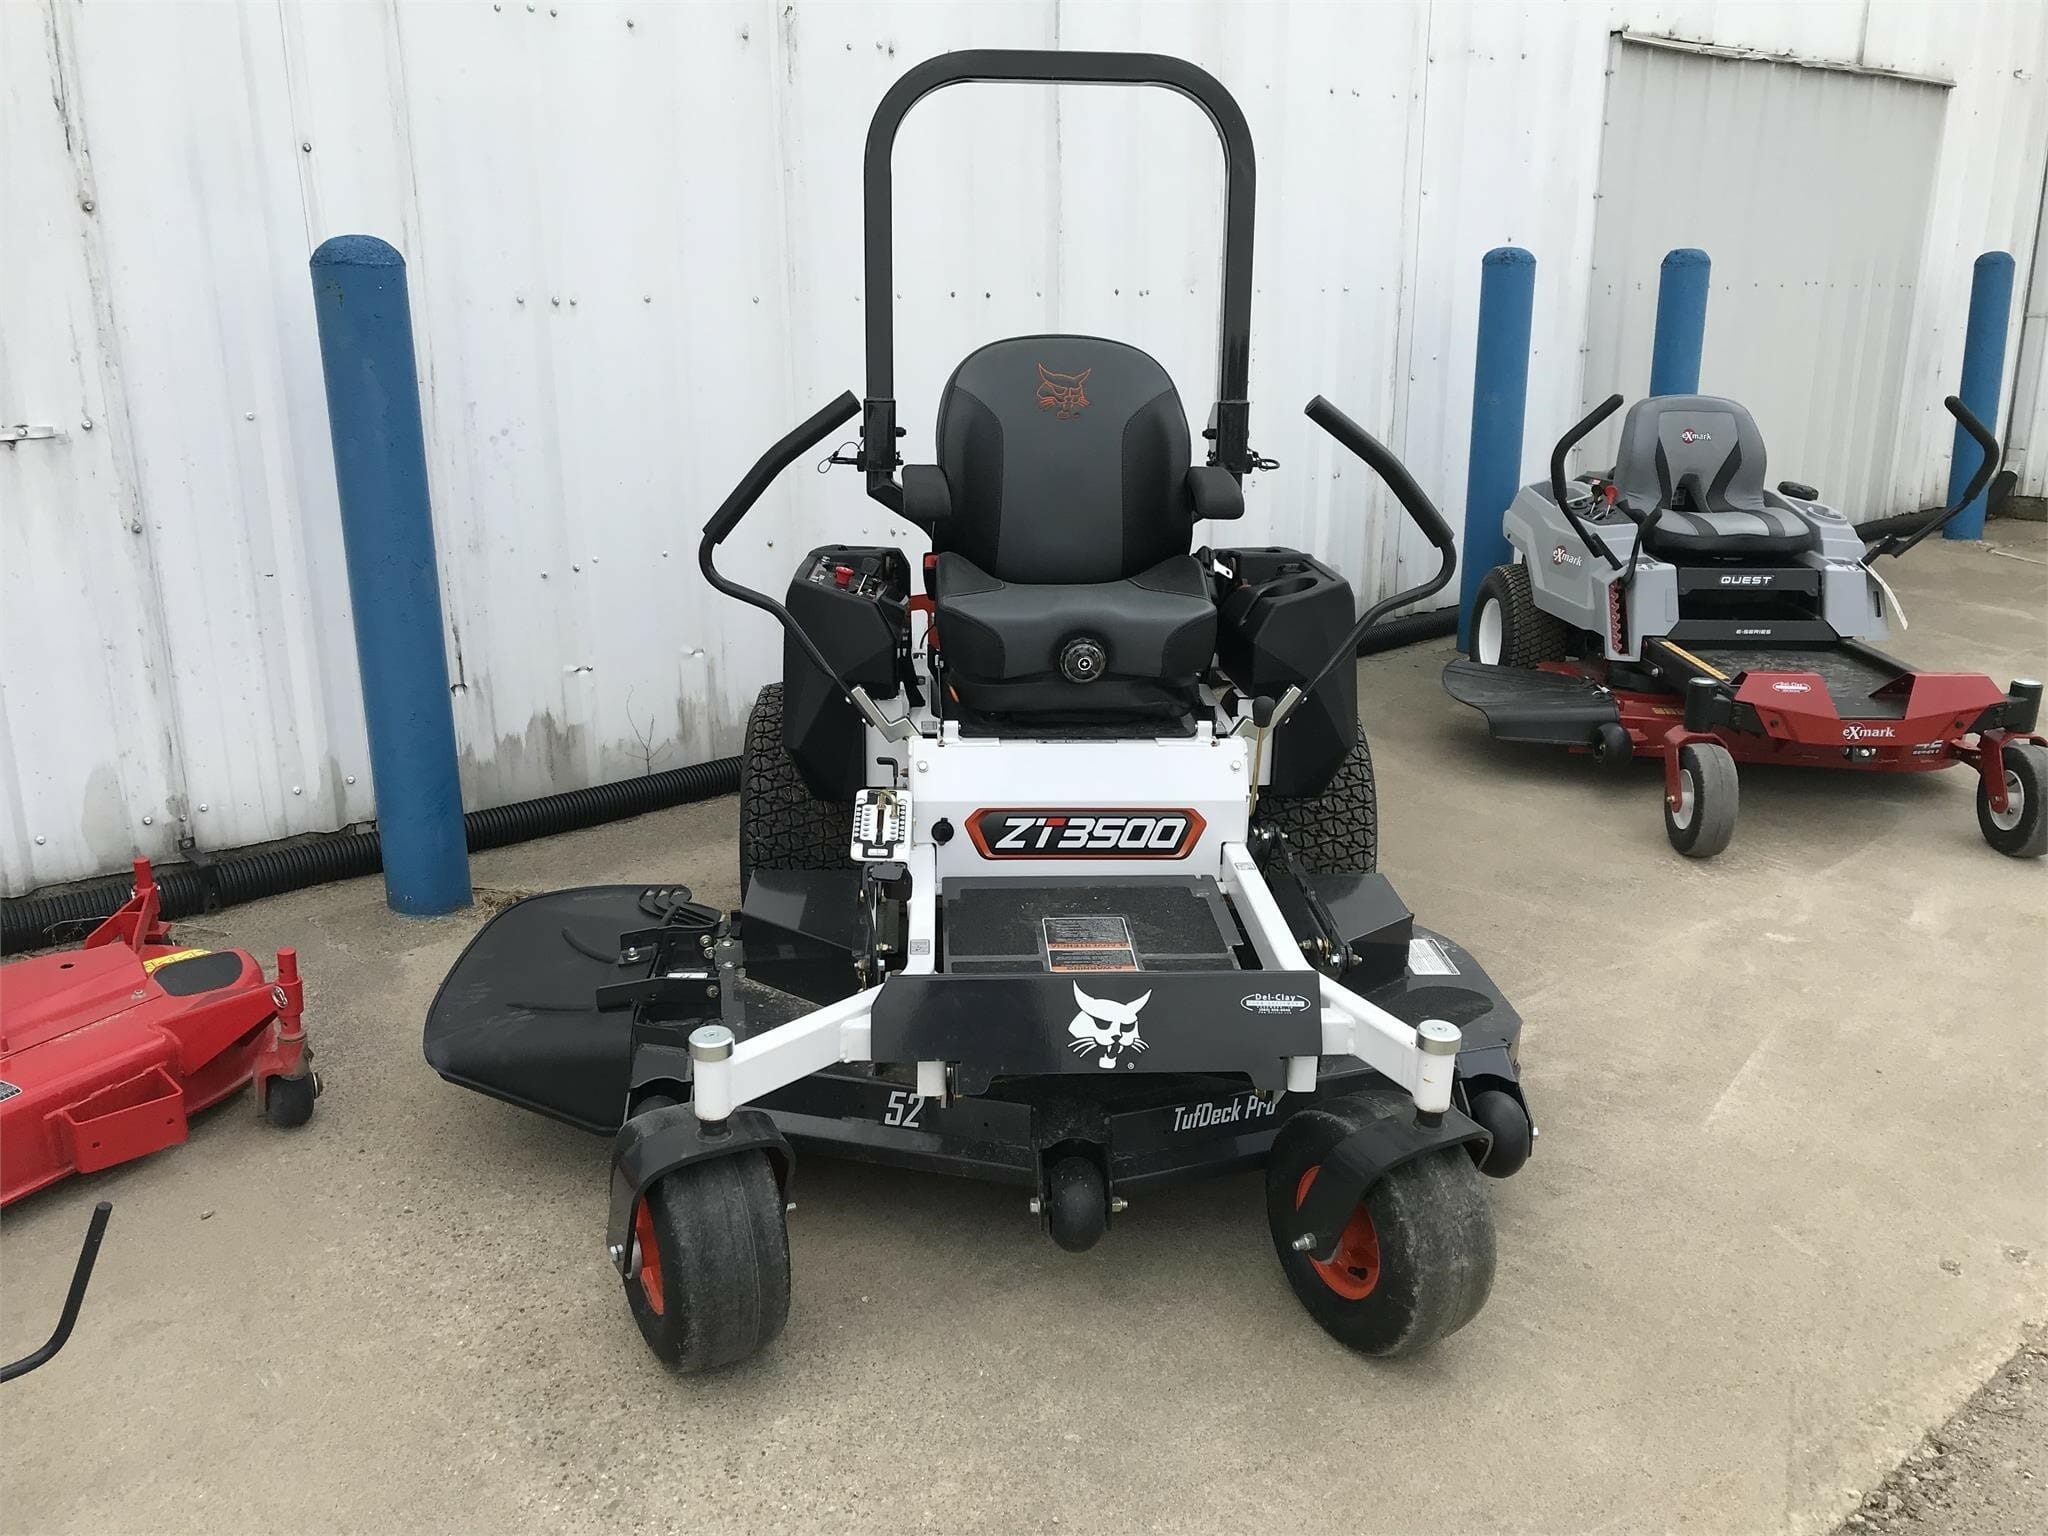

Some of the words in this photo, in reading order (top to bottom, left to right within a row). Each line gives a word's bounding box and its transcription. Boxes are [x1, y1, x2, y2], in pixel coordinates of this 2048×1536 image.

[1721, 576, 1772, 584] QUEST
[995, 817, 1187, 849] ZT3500
[1255, 993, 1296, 1002] Del-Clay
[884, 1091, 925, 1128] 52
[1174, 1098, 1242, 1132] TufDeck
